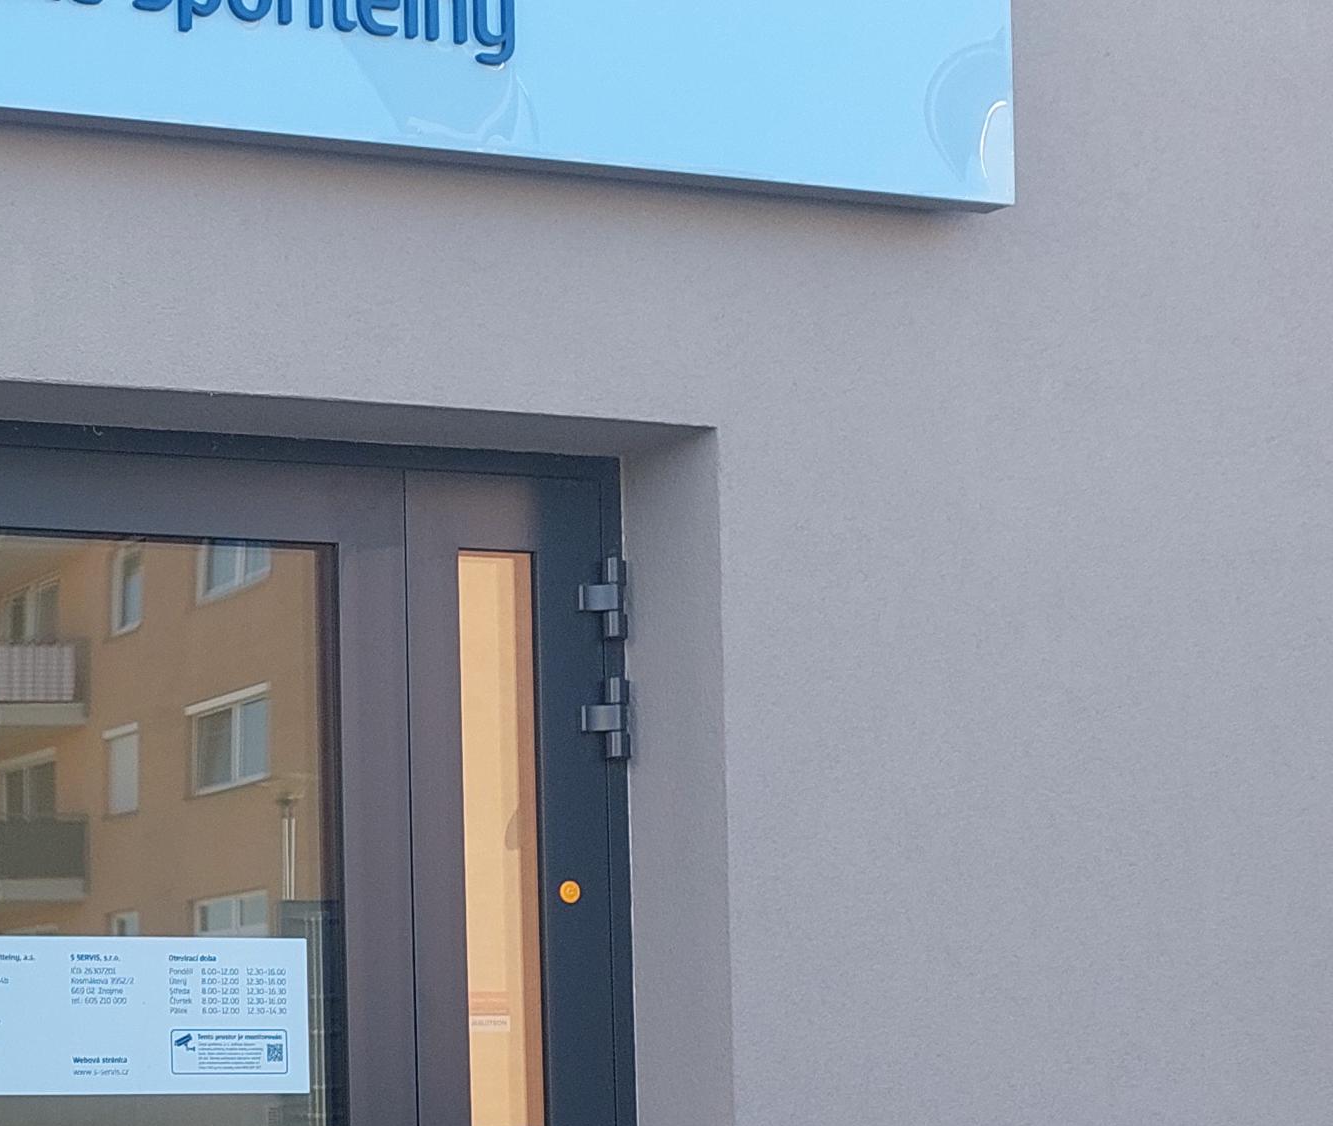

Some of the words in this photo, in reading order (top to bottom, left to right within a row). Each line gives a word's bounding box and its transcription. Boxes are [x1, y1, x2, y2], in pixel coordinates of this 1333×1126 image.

[200, 954, 217, 962] doba
[73, 1056, 101, 1064] Webová
[102, 1056, 128, 1064] stránka
